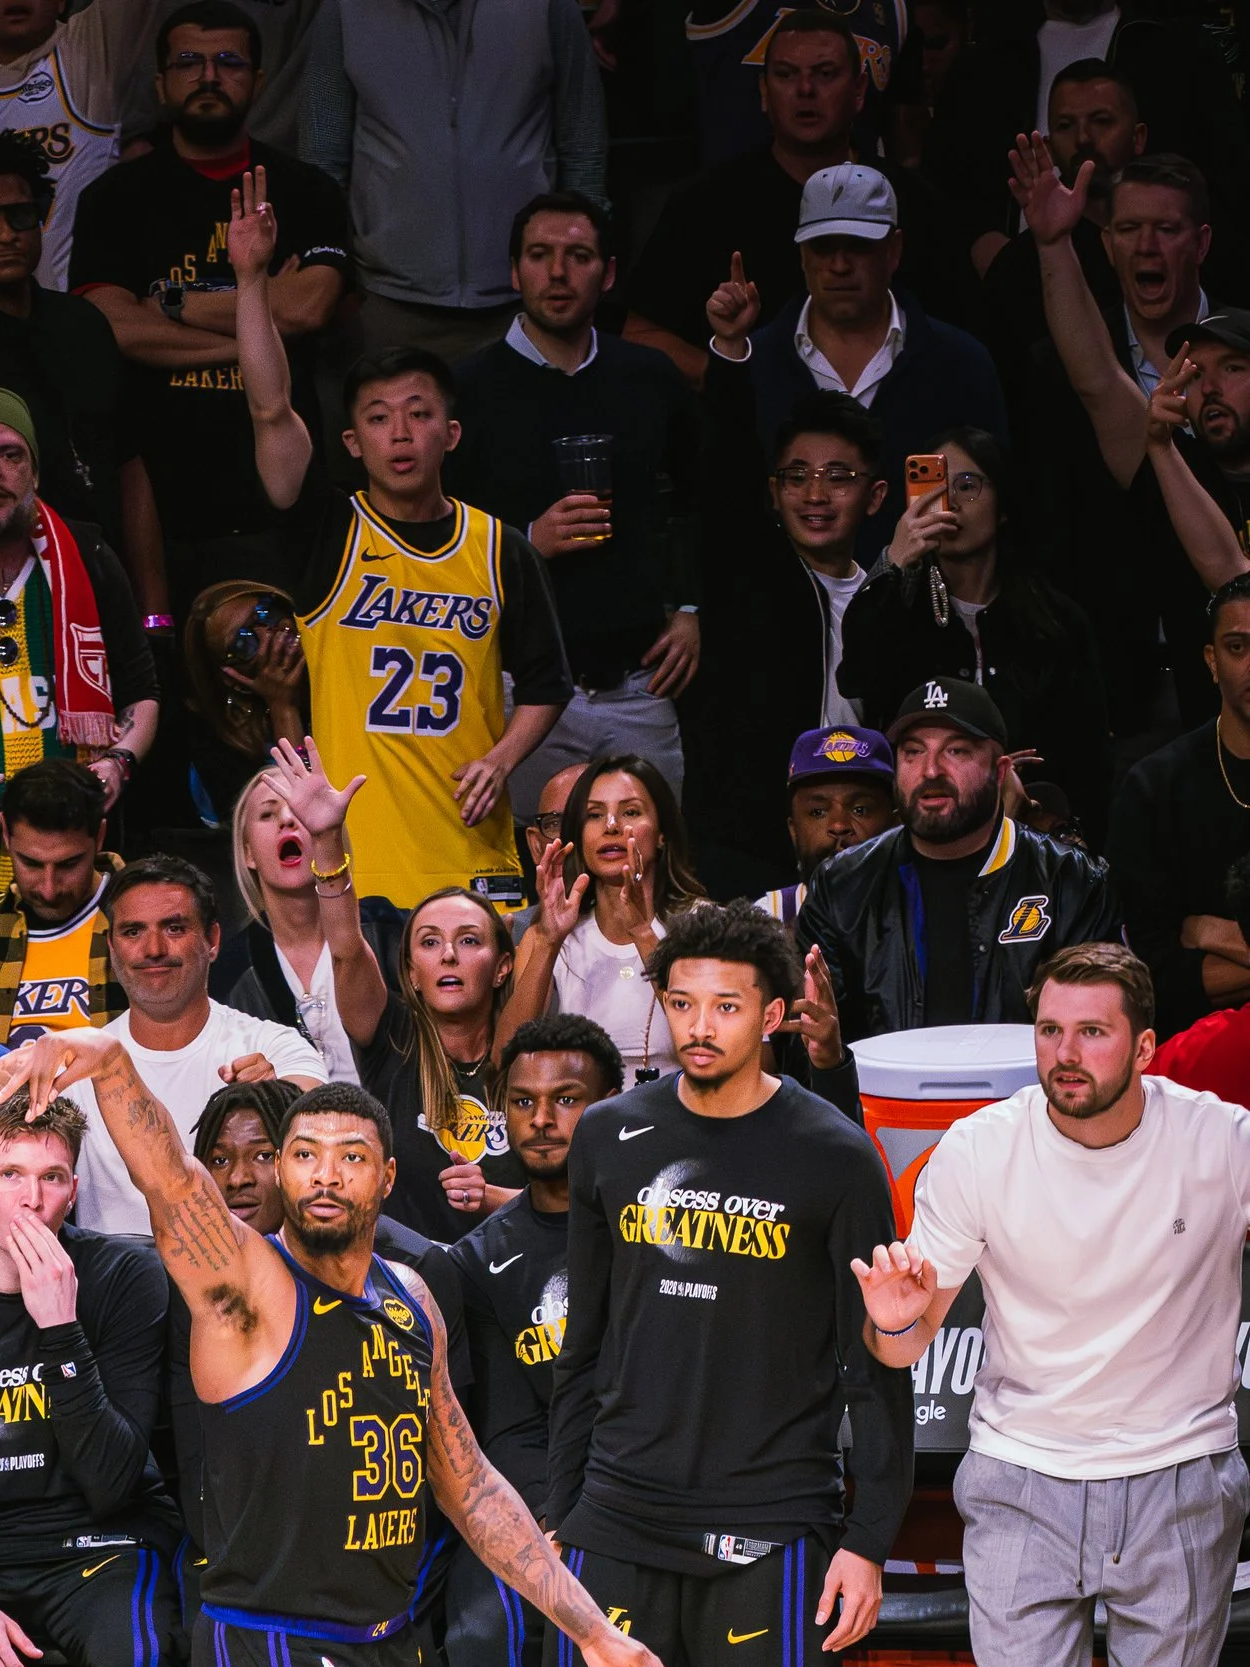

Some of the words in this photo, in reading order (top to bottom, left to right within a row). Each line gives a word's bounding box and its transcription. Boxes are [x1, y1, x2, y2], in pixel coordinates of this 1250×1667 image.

[338, 573, 494, 641] LAKERS
[365, 645, 465, 737] 23
[923, 680, 949, 709] LA
[812, 736, 872, 759] LAKERS
[637, 1177, 721, 1212] obsess
[723, 1194, 786, 1223] over
[619, 1203, 791, 1260] GREATNESS
[684, 1282, 718, 1301] PLAYOFFS
[306, 1371, 354, 1446] LOS
[361, 1323, 432, 1424] ANGEL
[910, 1326, 986, 1395] AYO
[9, 1452, 46, 1471] PLAYOFFS
[350, 1412, 424, 1501] 36
[344, 1506, 419, 1551] LAKERS
